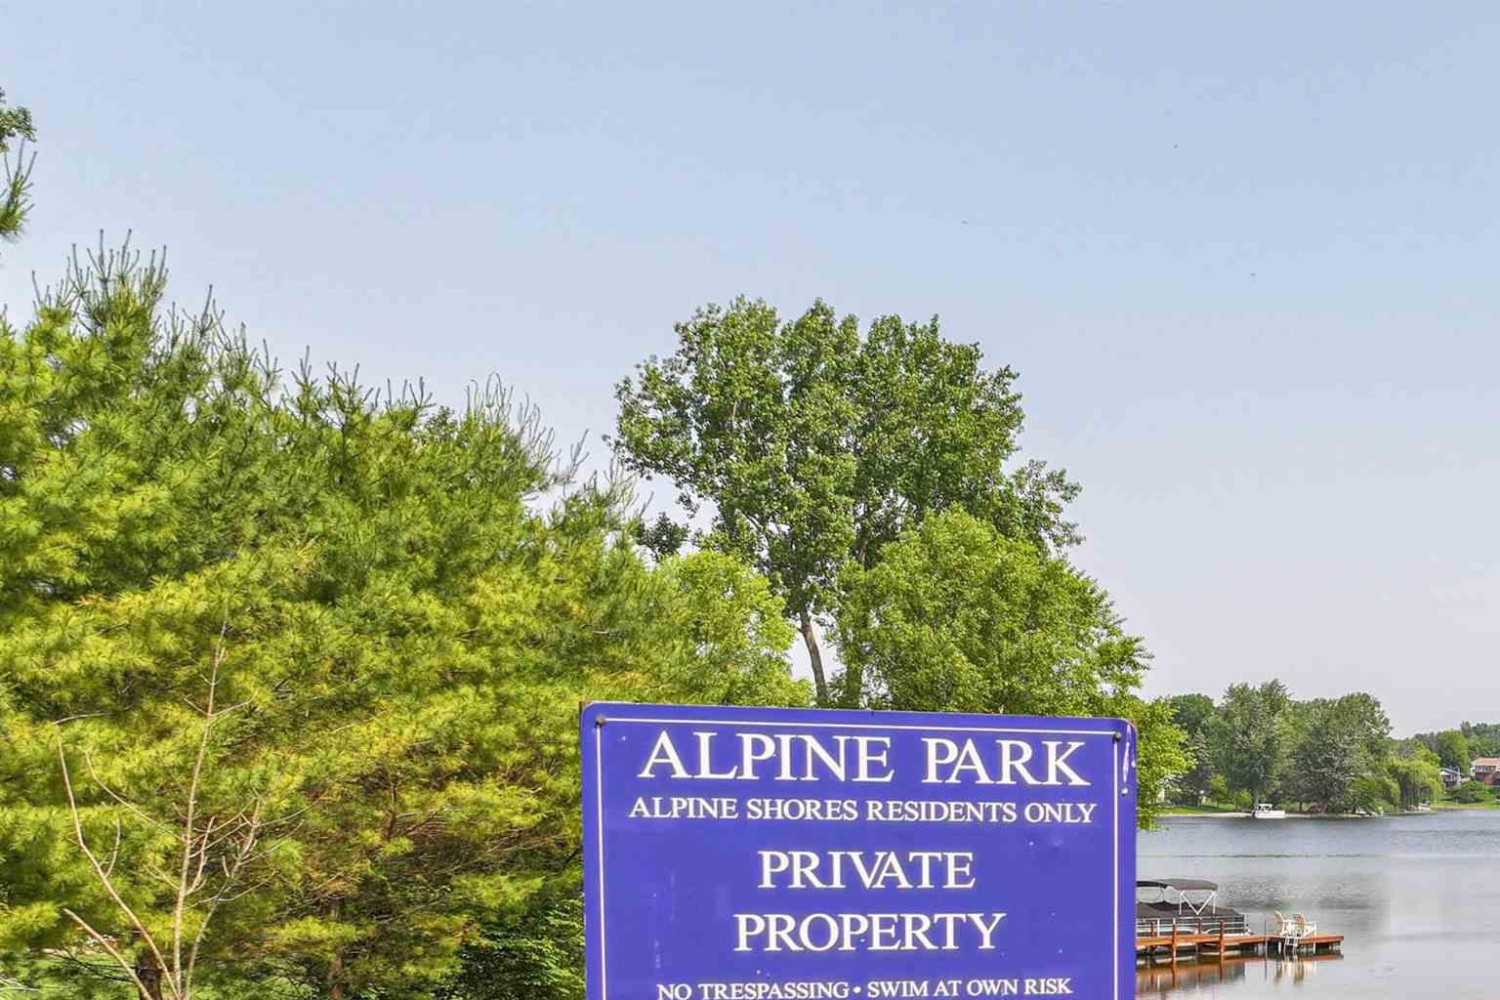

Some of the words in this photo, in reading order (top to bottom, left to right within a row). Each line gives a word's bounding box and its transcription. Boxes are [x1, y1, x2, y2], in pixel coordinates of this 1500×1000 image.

[637, 729, 895, 783] ALPINE
[921, 737, 1092, 787] PARK
[628, 797, 738, 820] ALPINE
[746, 799, 859, 821] SHORES
[866, 800, 1017, 823] RESIDENTS
[1024, 803, 1097, 824] ONLY
[757, 851, 977, 889] PRIVATE
[733, 913, 1007, 952] PROPERTY
[657, 983, 692, 1000] NO
[698, 982, 850, 1000] TRESPASSING
[867, 980, 929, 998] SWIM
[933, 980, 962, 996] AT
[966, 979, 1018, 996] OWN
[1024, 978, 1073, 995] RISK
